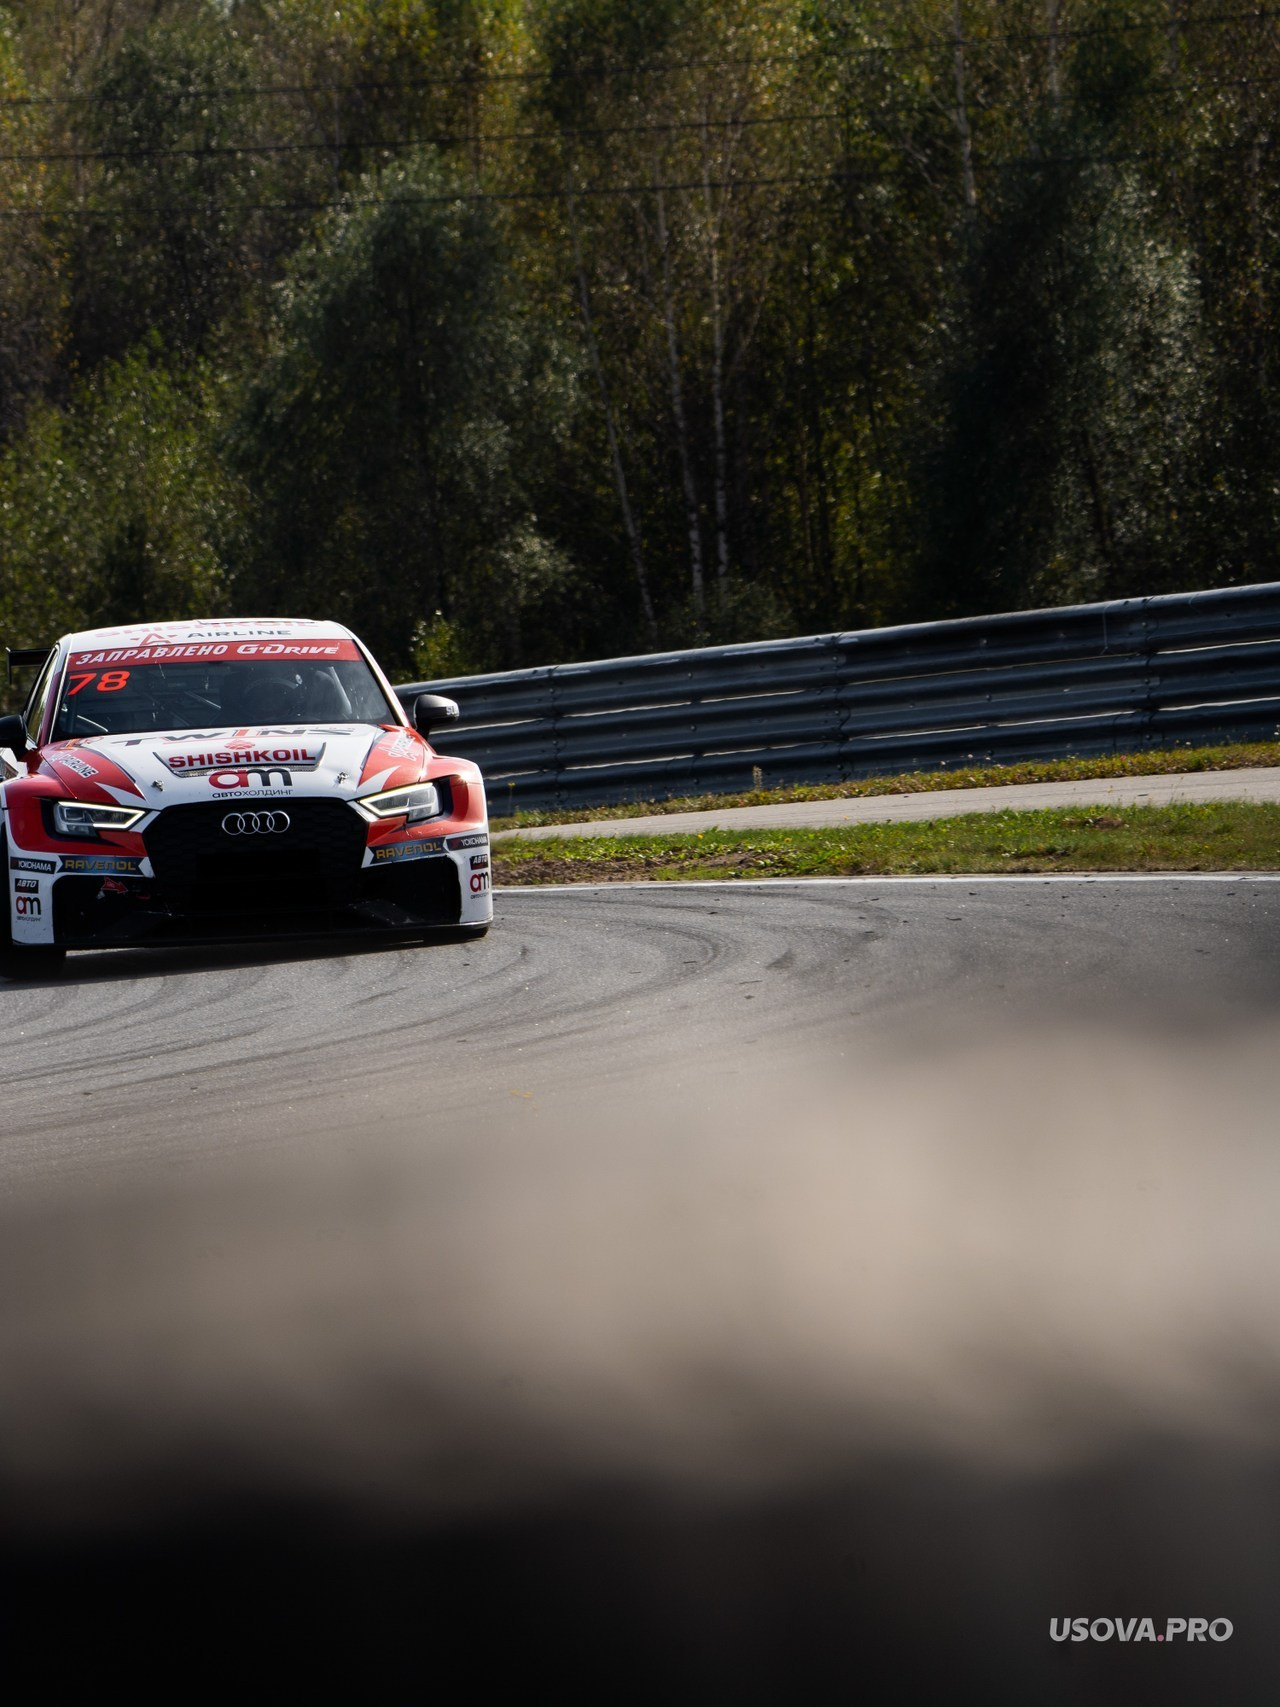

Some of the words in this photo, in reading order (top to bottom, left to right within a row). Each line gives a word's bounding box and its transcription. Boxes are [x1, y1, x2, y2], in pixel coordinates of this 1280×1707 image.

[187, 630, 292, 639] AIRLINE
[75, 644, 228, 665] ЗАПРАВЛЕНО
[67, 670, 131, 696] 78
[169, 748, 316, 768] SHISHKOIL
[212, 789, 293, 799] автохолдинг
[376, 842, 443, 859] RAVENOL
[18, 860, 52, 871] YOKOHAMA
[64, 860, 136, 870] RAVENOL
[17, 880, 37, 888] АВТО
